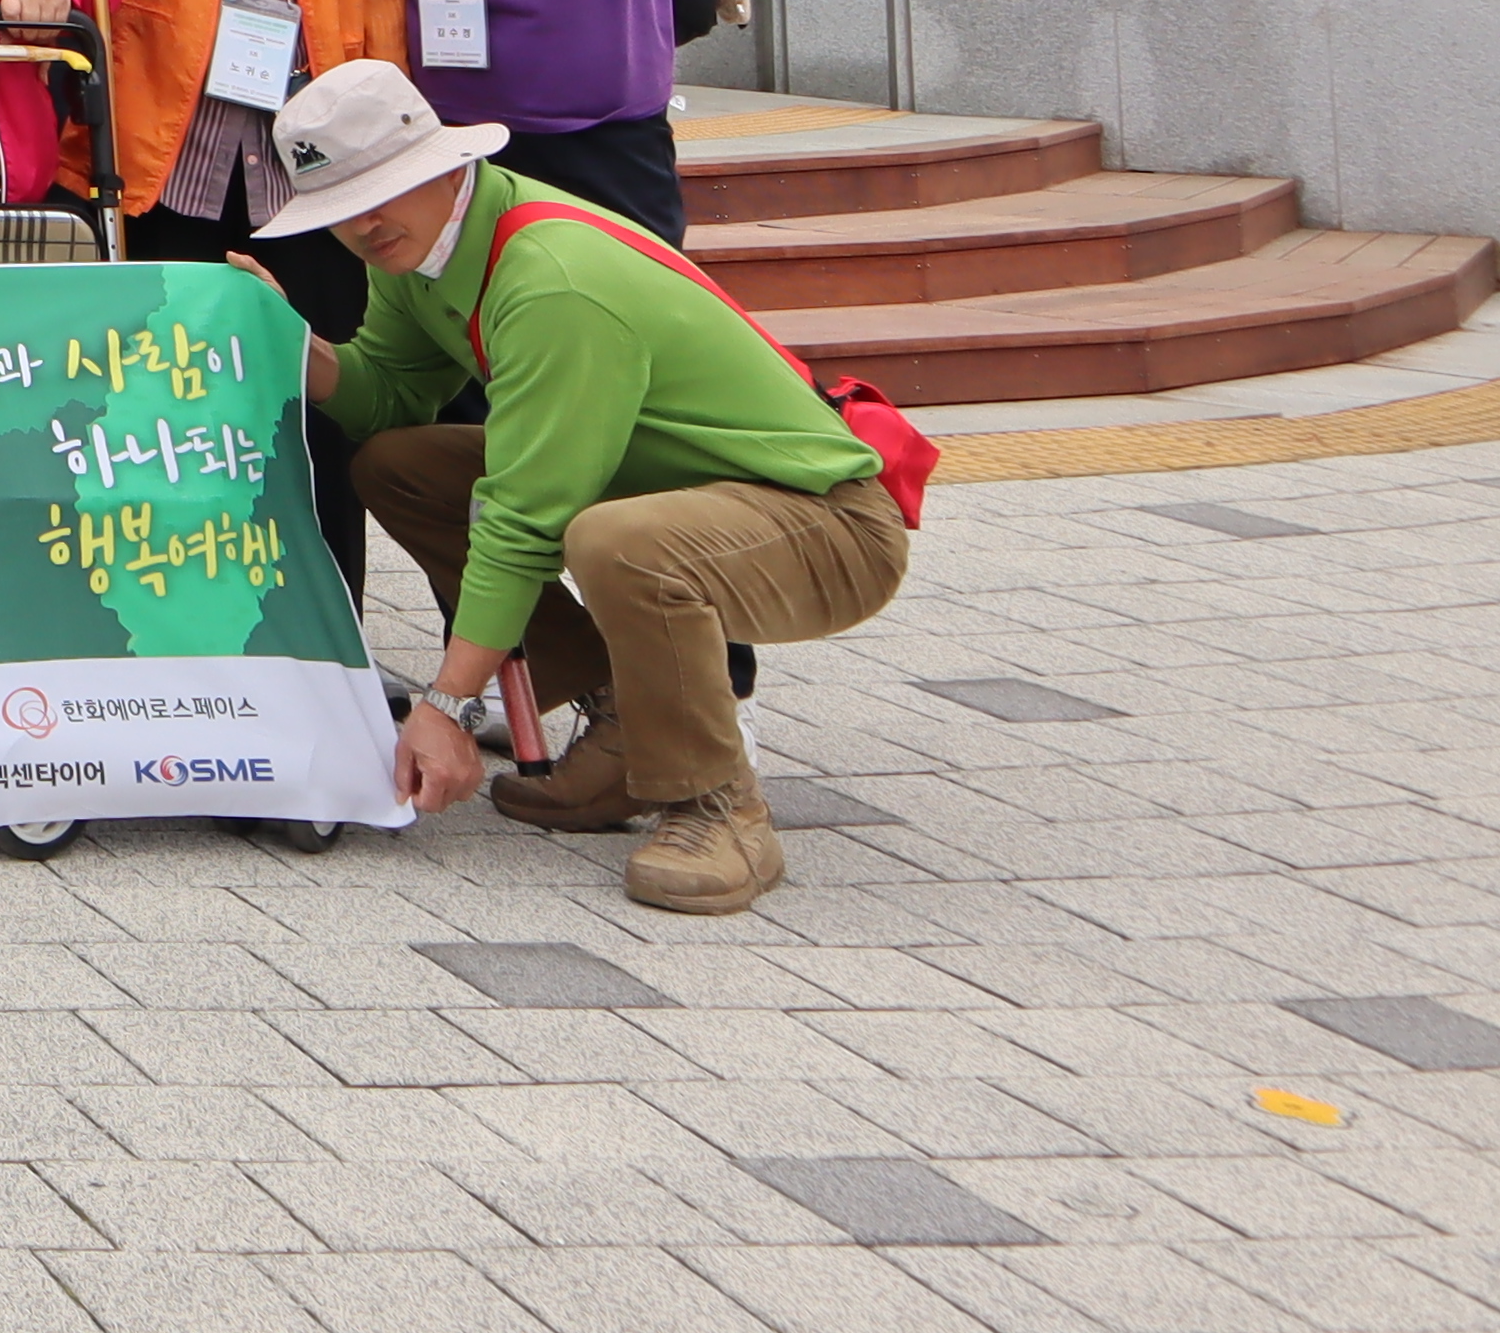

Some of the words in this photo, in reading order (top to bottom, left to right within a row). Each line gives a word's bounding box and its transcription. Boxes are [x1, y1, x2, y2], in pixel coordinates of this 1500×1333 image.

[66, 323, 245, 400] 사람이
[51, 418, 264, 489] 하나되는
[38, 502, 285, 598] 행복여행!
[61, 696, 259, 723] 한화에어로스페이스
[133, 755, 275, 787] KOSME
